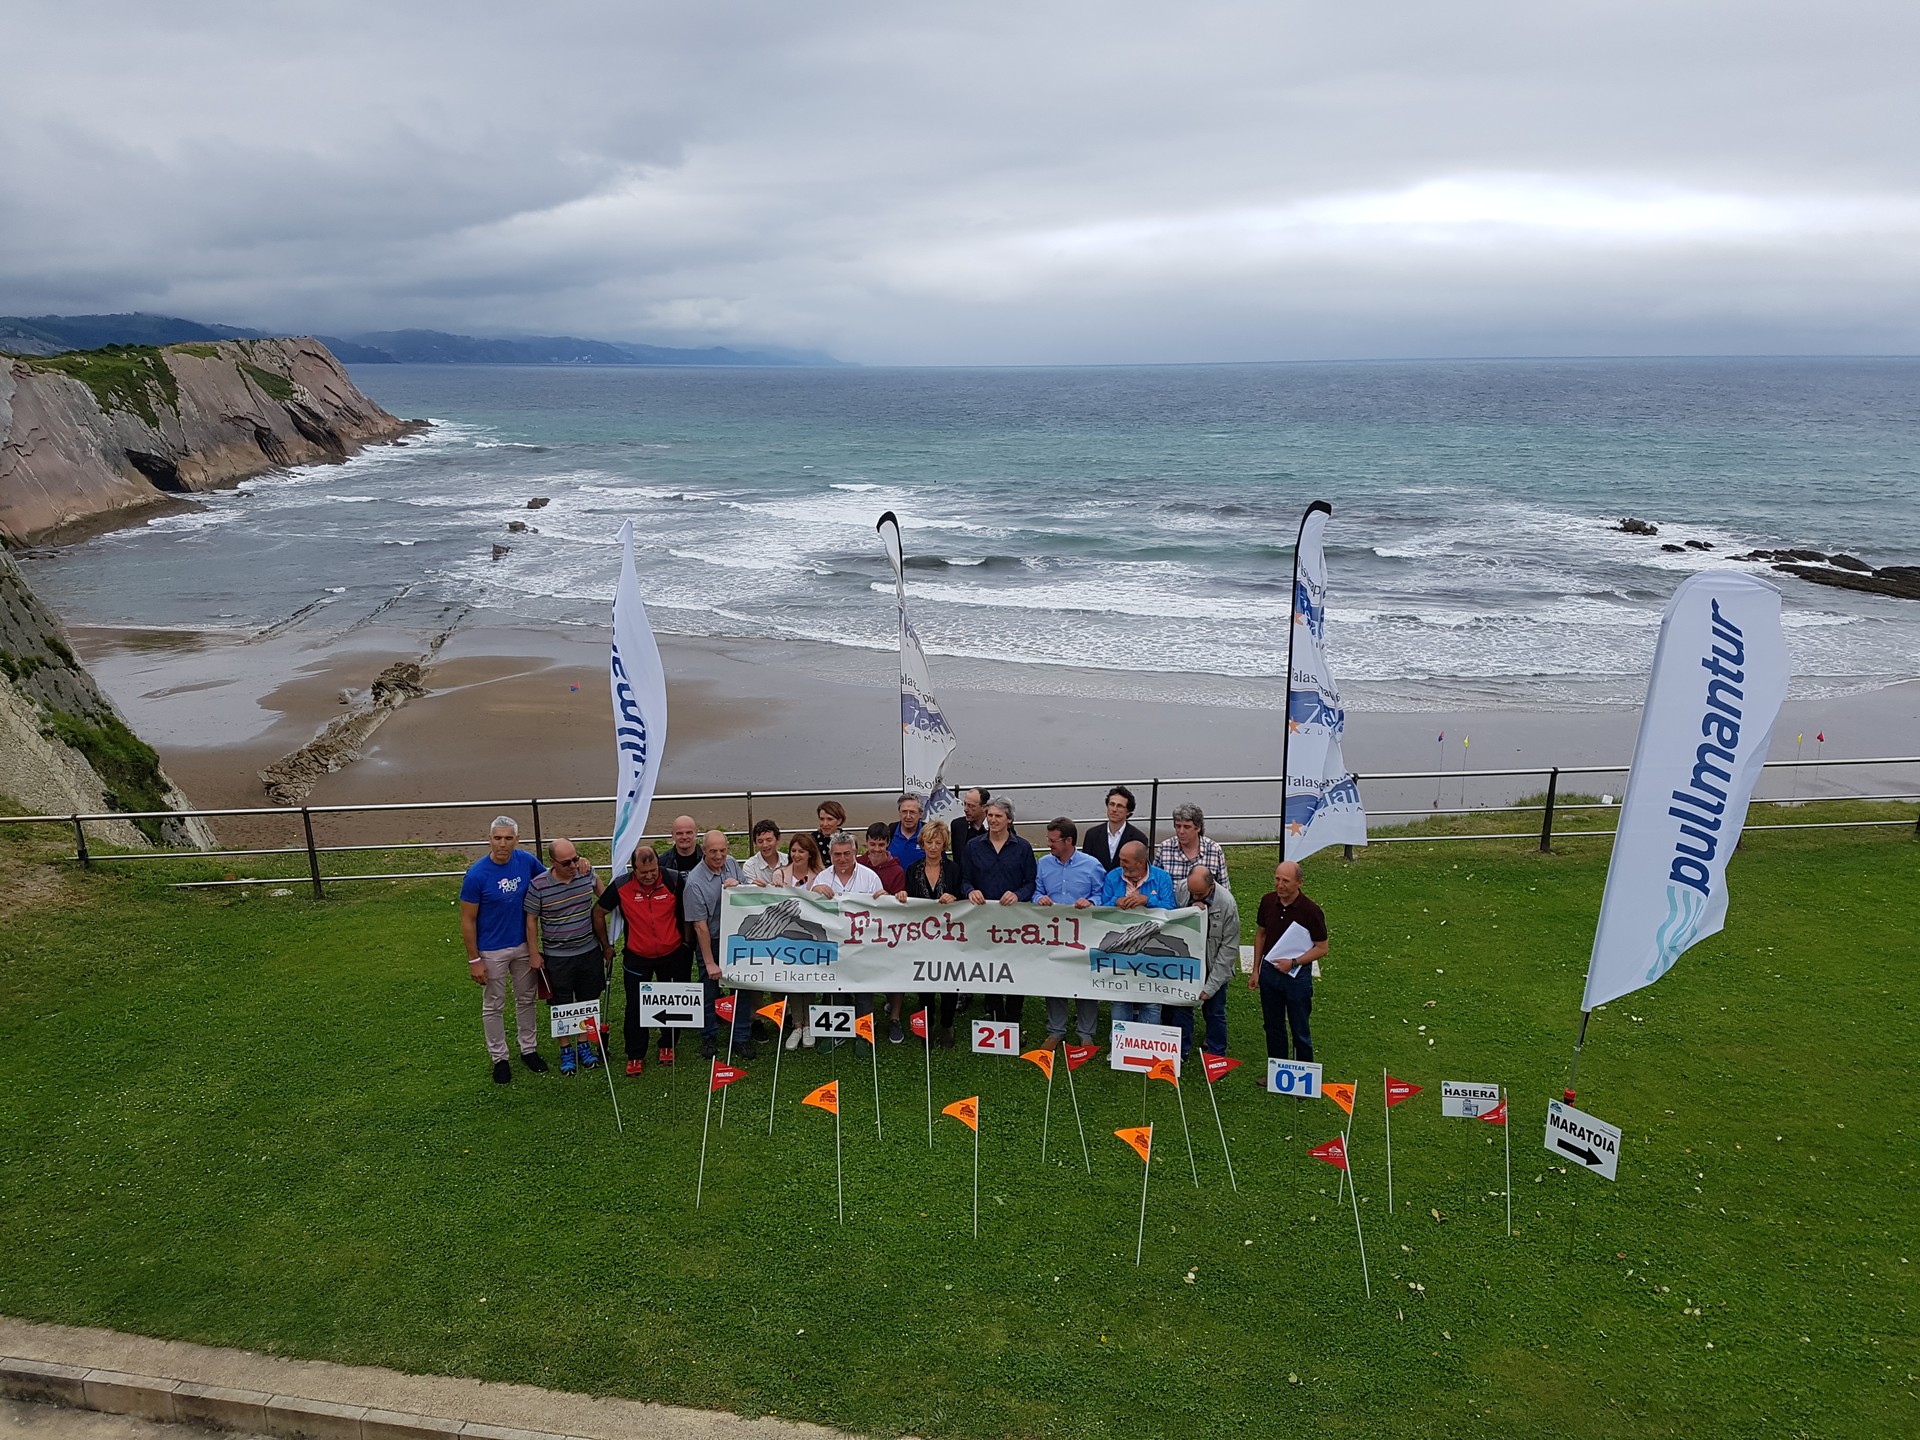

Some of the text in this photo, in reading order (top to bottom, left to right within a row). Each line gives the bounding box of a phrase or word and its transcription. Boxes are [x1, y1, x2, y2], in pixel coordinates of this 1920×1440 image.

[1669, 597, 1745, 898] pullmantur
[987, 917, 1086, 950] trail
[732, 946, 831, 966] FLYSCH
[727, 971, 836, 982] Kirol Elkartea
[913, 961, 1015, 984] ZUMAIA
[1096, 957, 1194, 984] FLYSCH
[642, 994, 701, 1007] MARATOIA
[1092, 979, 1197, 1001] Kirol Elkartea
[552, 1005, 599, 1019] BUKAERA
[814, 1011, 851, 1032] 42
[977, 1027, 1011, 1050] 21
[1124, 1037, 1178, 1054] MARATOIA
[1277, 1063, 1306, 1071] KADETEAK
[1275, 1069, 1313, 1096] 01
[1444, 1088, 1497, 1099] HASIERA
[1549, 1113, 1616, 1155] MARATOIA
